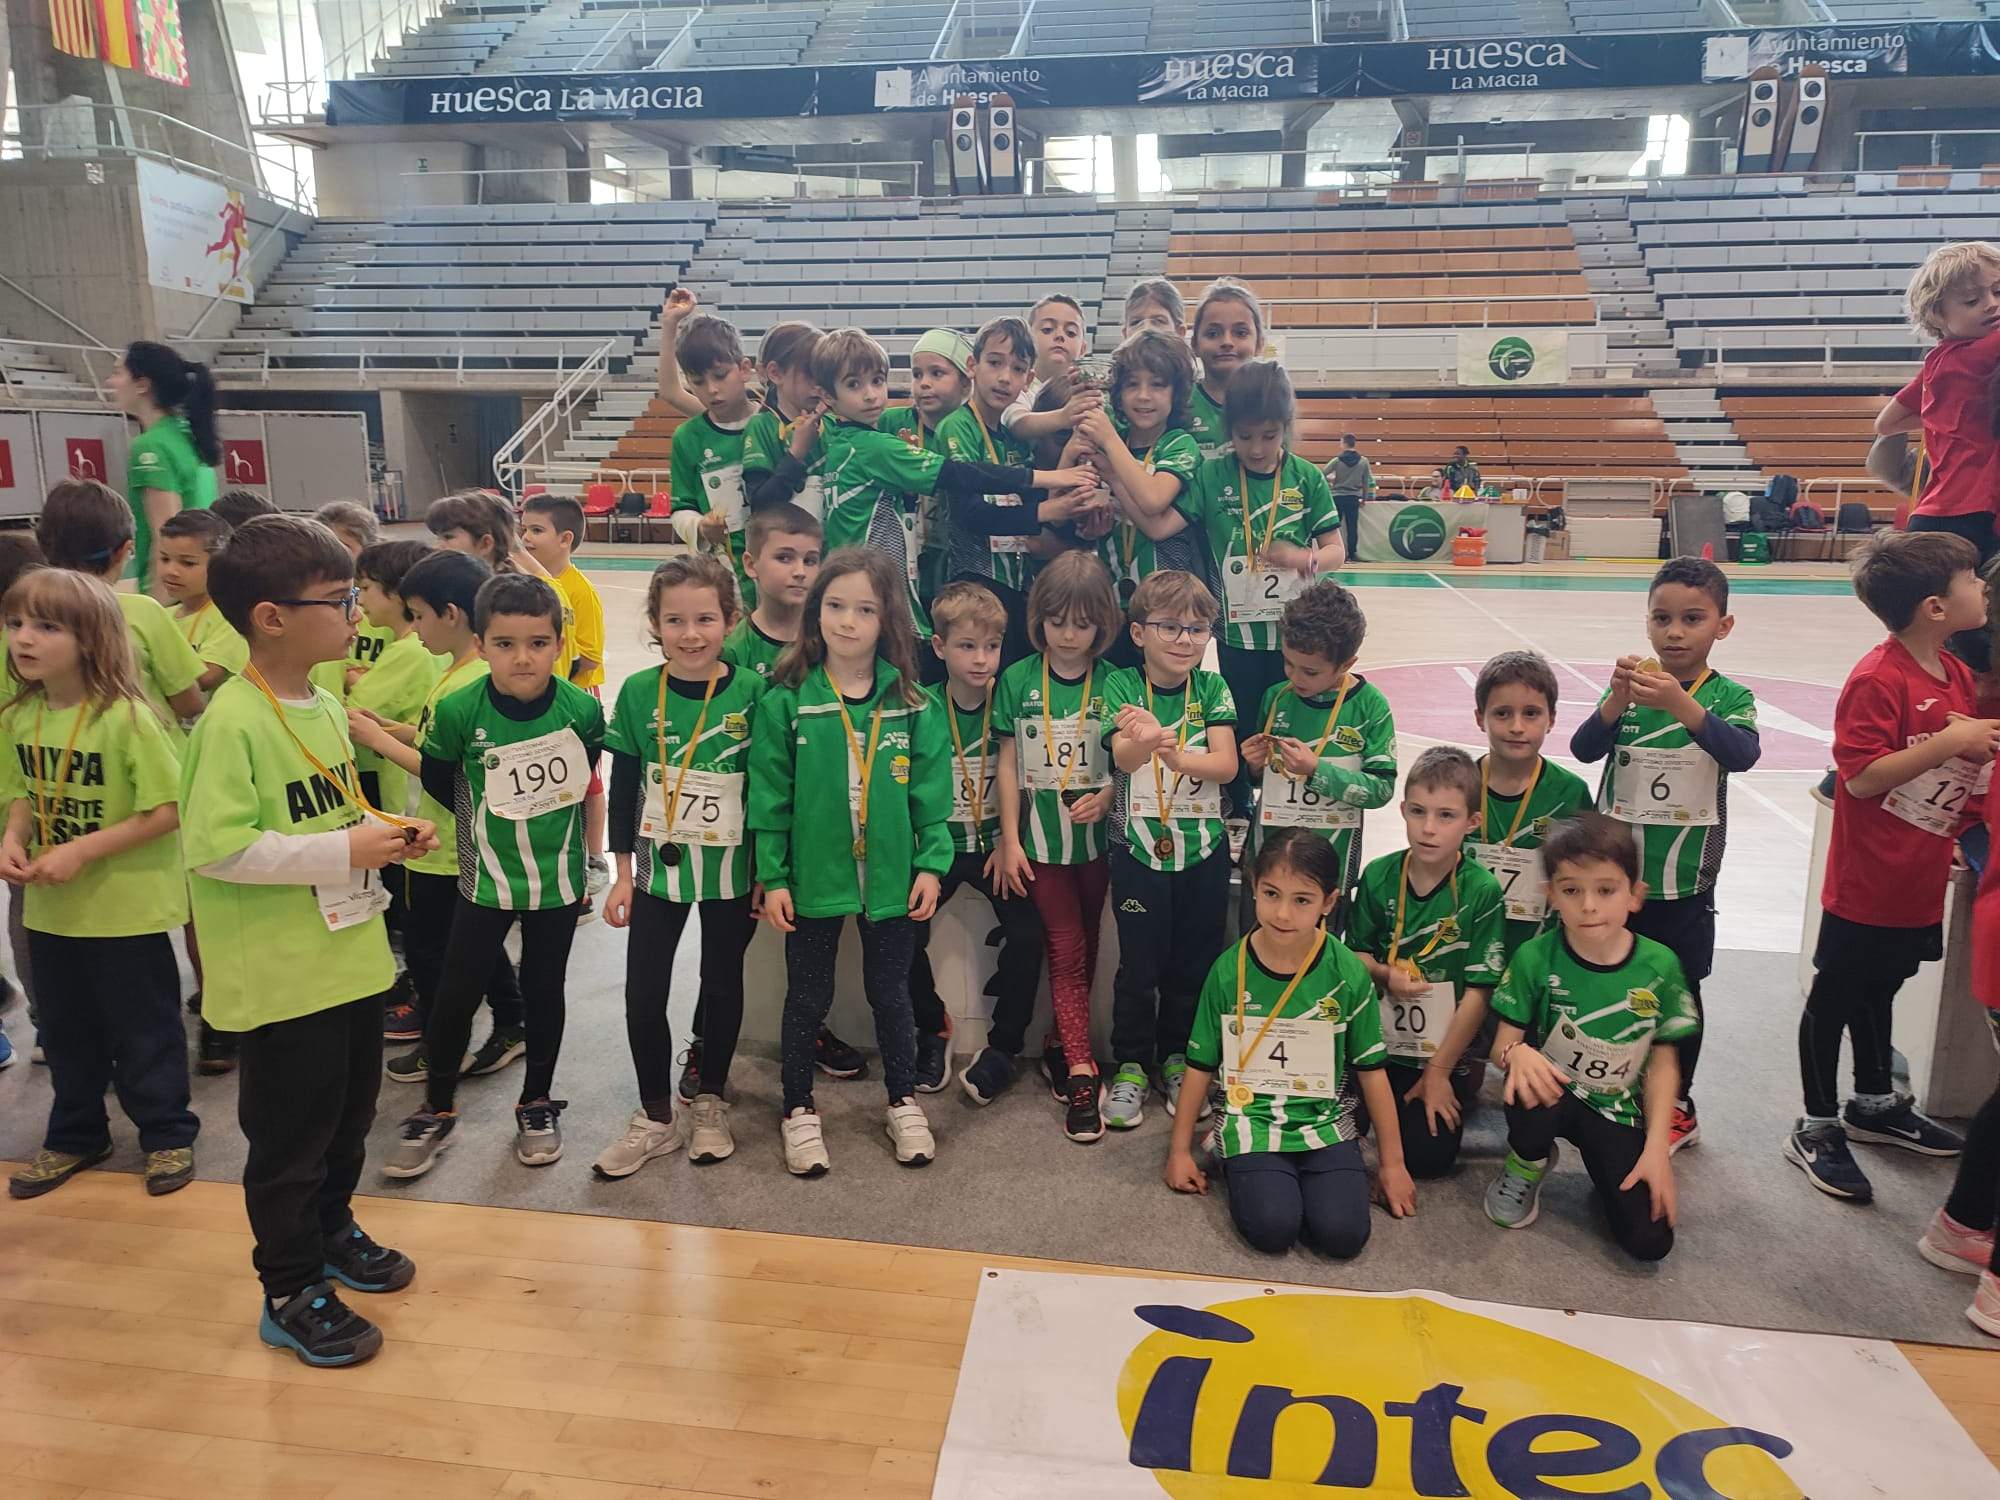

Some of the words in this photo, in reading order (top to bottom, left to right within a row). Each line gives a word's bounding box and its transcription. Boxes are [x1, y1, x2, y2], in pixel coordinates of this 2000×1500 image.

[917, 67, 1040, 89] Ayuntamiento
[1788, 56, 1868, 74] Hesca
[916, 92, 937, 106] de
[1263, 574, 1280, 599] 2
[1043, 740, 1088, 767] 181
[508, 756, 568, 796] 190
[953, 775, 997, 801] 87
[1650, 772, 1671, 801] 6
[1393, 1005, 1426, 1034] 20
[1268, 1041, 1289, 1069] 4
[1567, 1050, 1632, 1080] 184
[1129, 1306, 1794, 1500] intec
